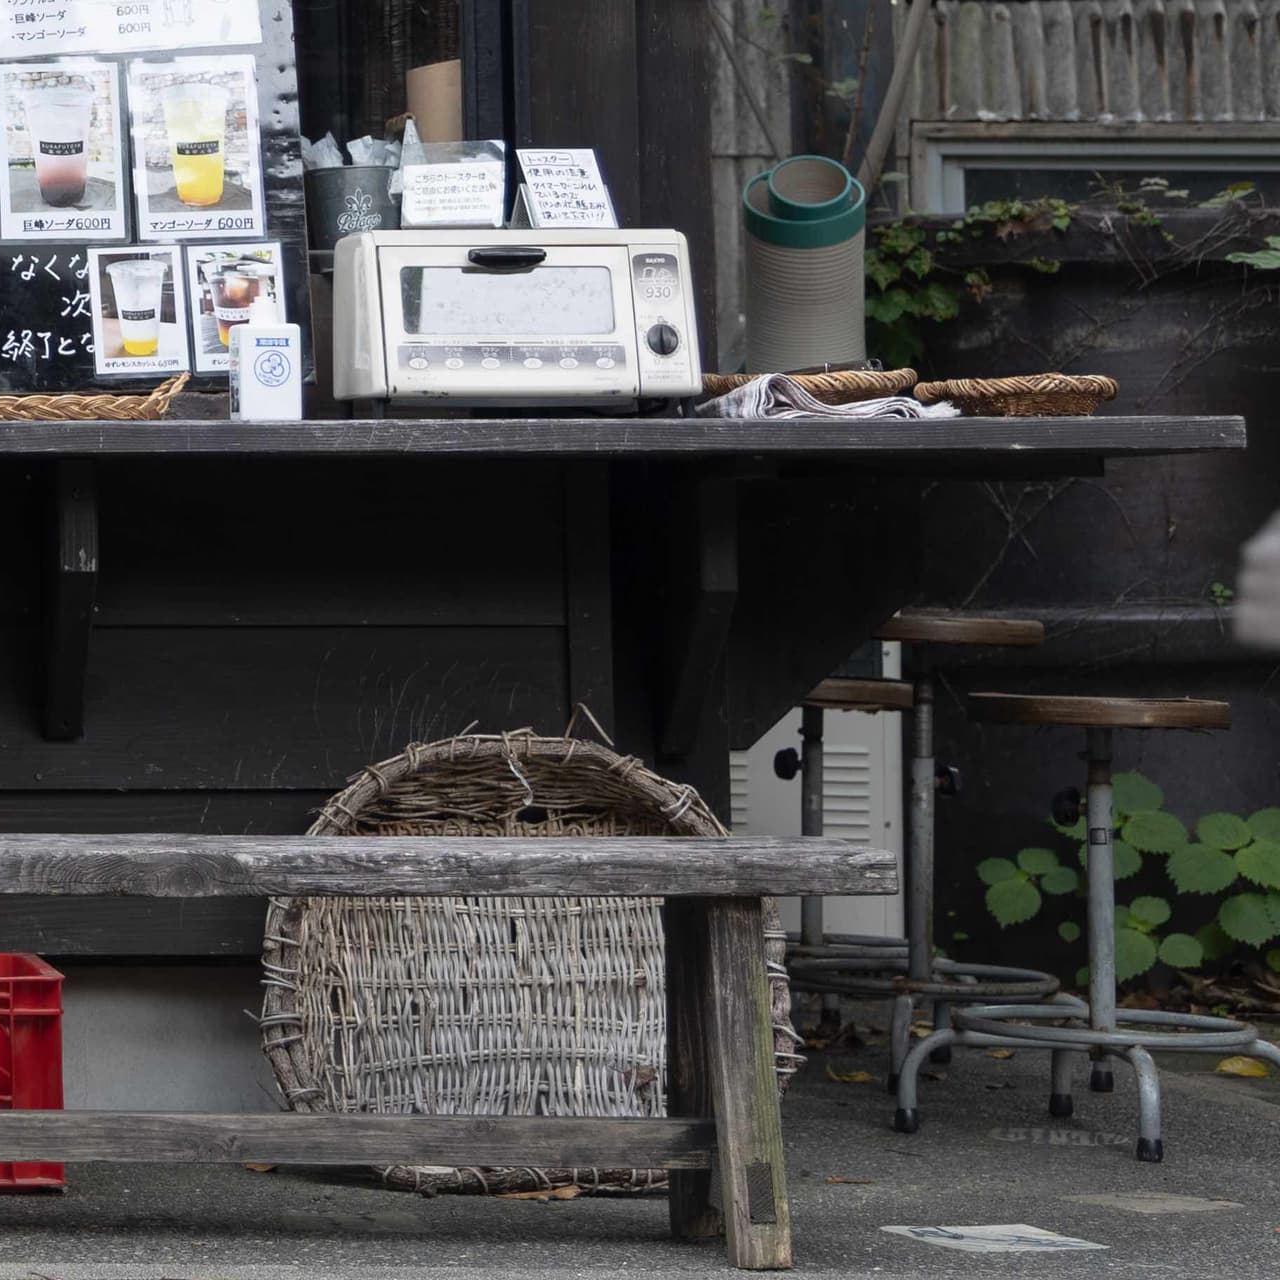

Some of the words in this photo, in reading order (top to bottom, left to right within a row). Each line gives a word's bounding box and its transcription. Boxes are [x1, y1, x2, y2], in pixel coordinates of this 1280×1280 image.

[116, 4, 150, 17] 600円
[118, 21, 152, 34] 600円
[217, 218, 255, 231] 600円
[645, 286, 672, 299] 930
